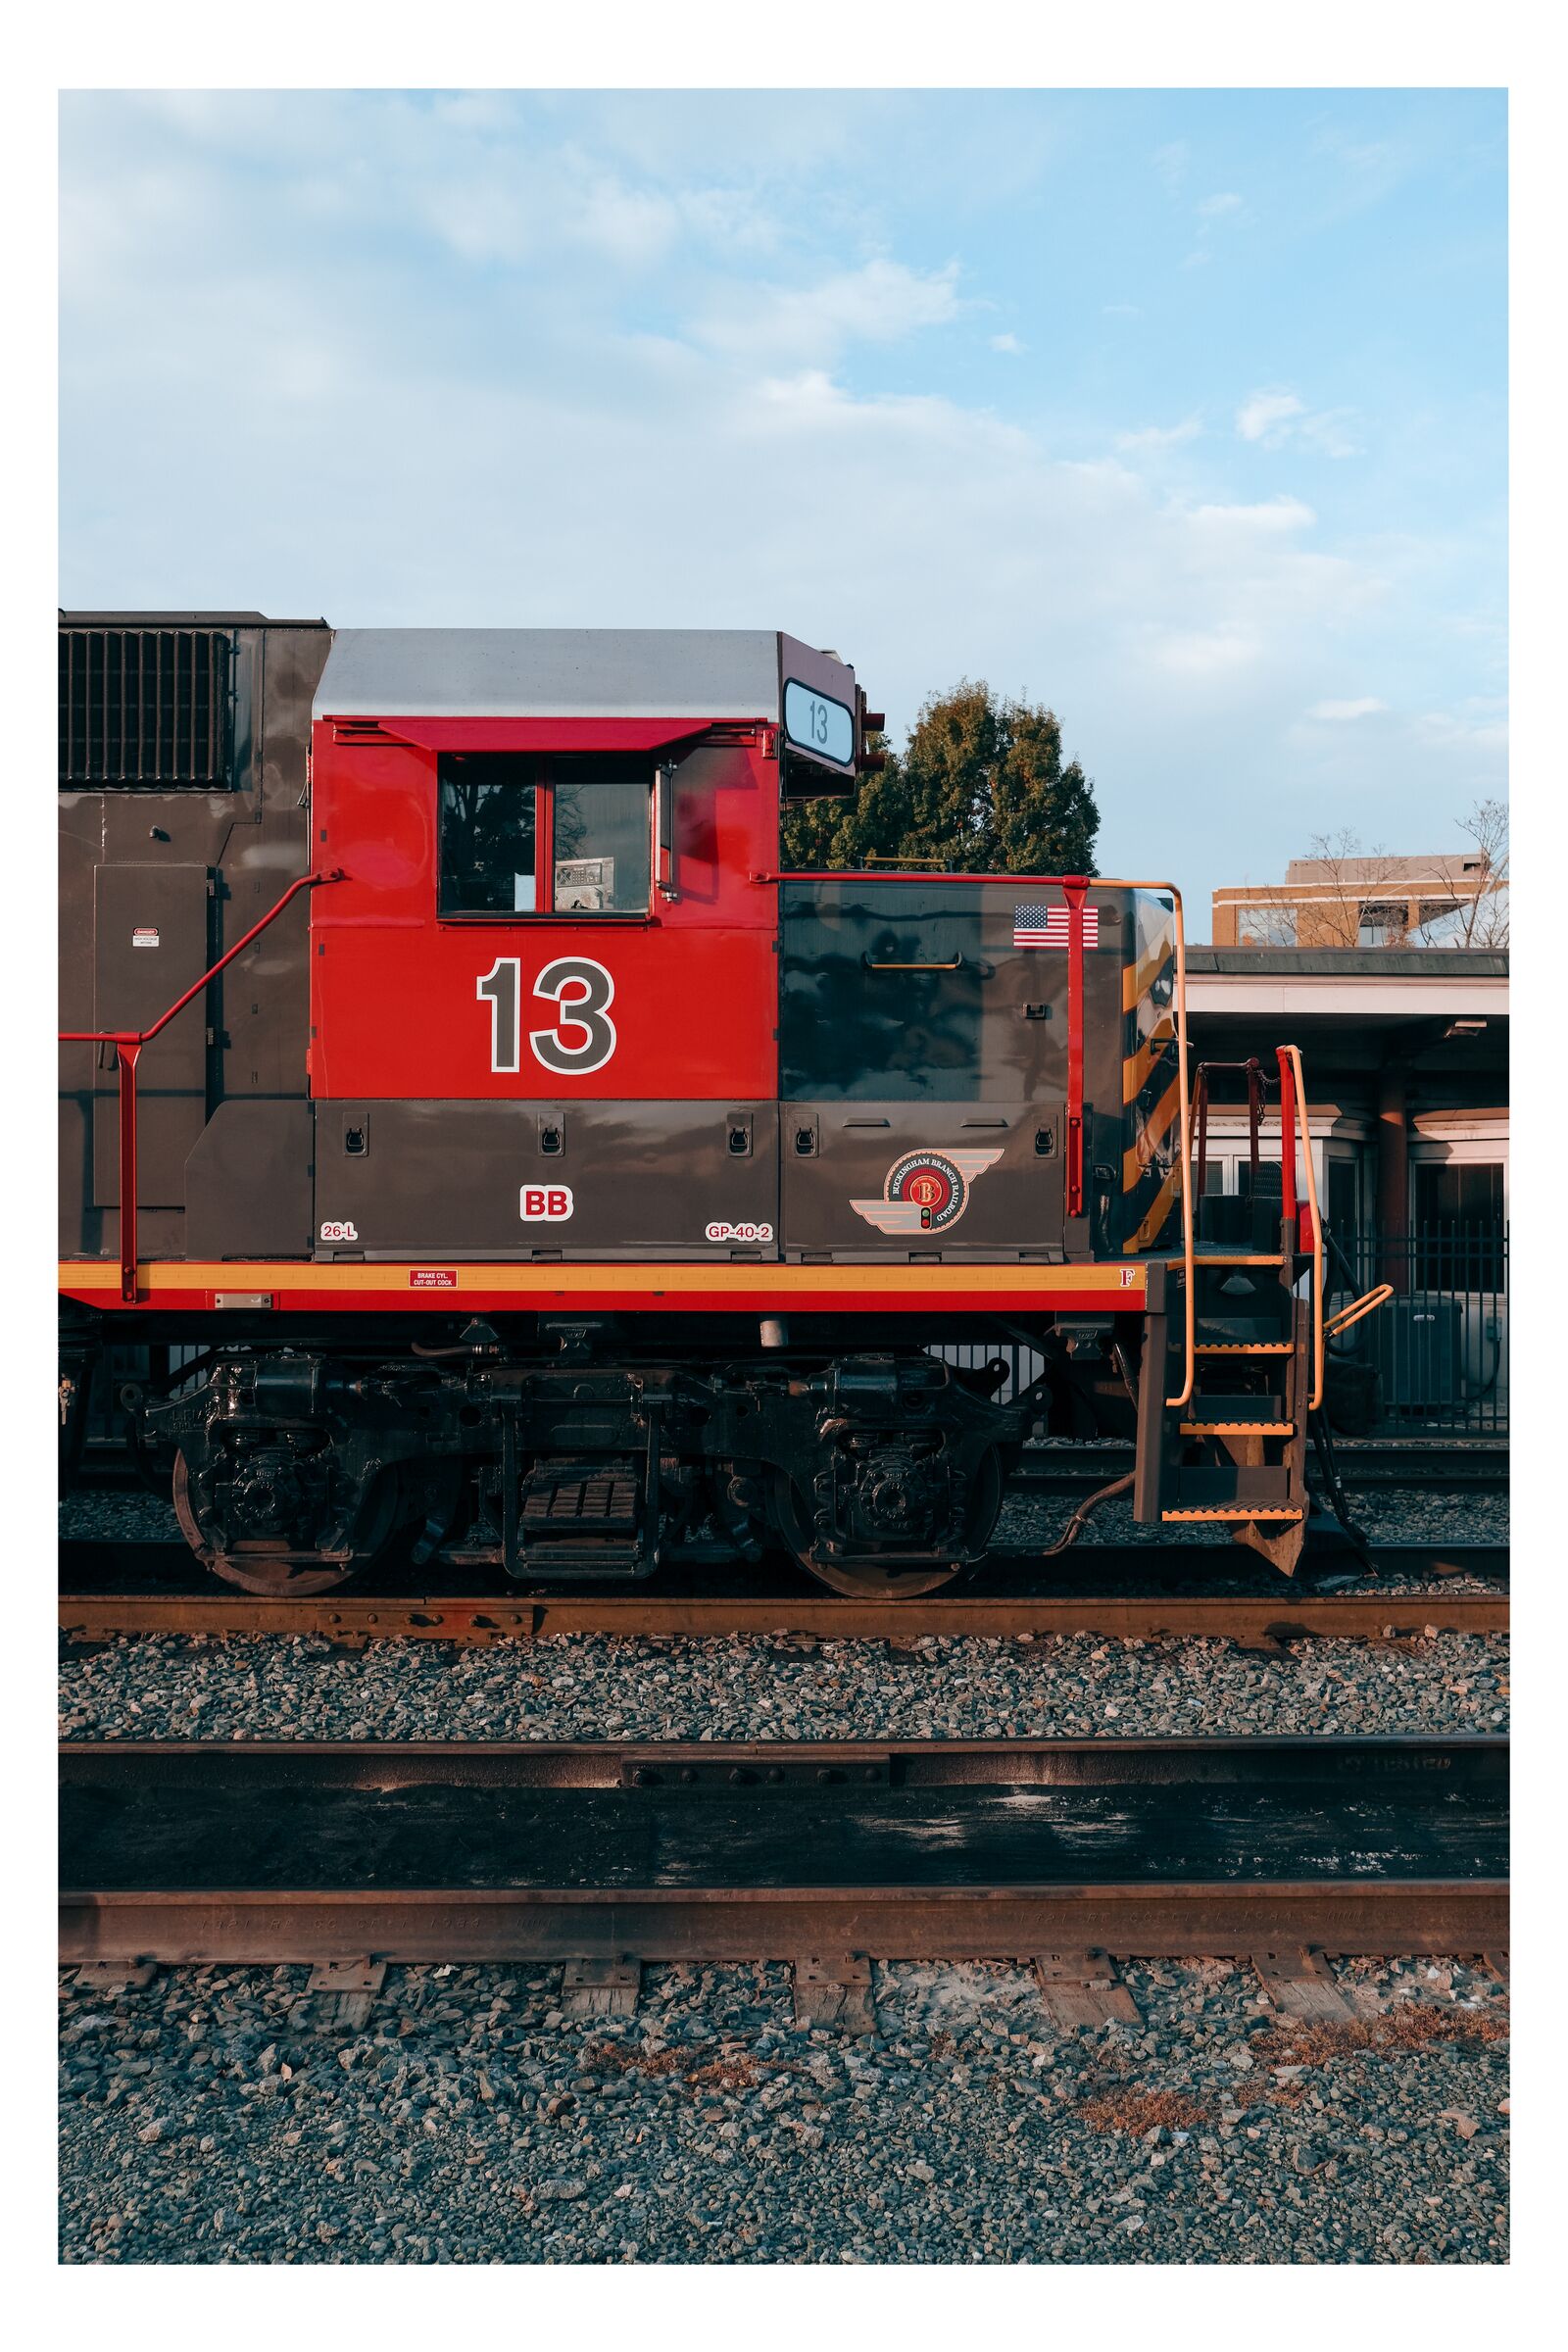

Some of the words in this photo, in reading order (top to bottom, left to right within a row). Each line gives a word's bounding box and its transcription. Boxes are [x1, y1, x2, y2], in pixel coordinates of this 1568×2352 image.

[809, 700, 828, 745] 13
[476, 956, 617, 1076] 13
[892, 1157, 930, 1195] BUCKINGHAM
[930, 1158, 957, 1187] BRANCH
[525, 1190, 568, 1216] BB
[936, 1184, 959, 1222] RAILROAD
[323, 1225, 355, 1238] 26-L
[709, 1225, 769, 1238] GP-40-2
[1120, 1269, 1135, 1287] F
